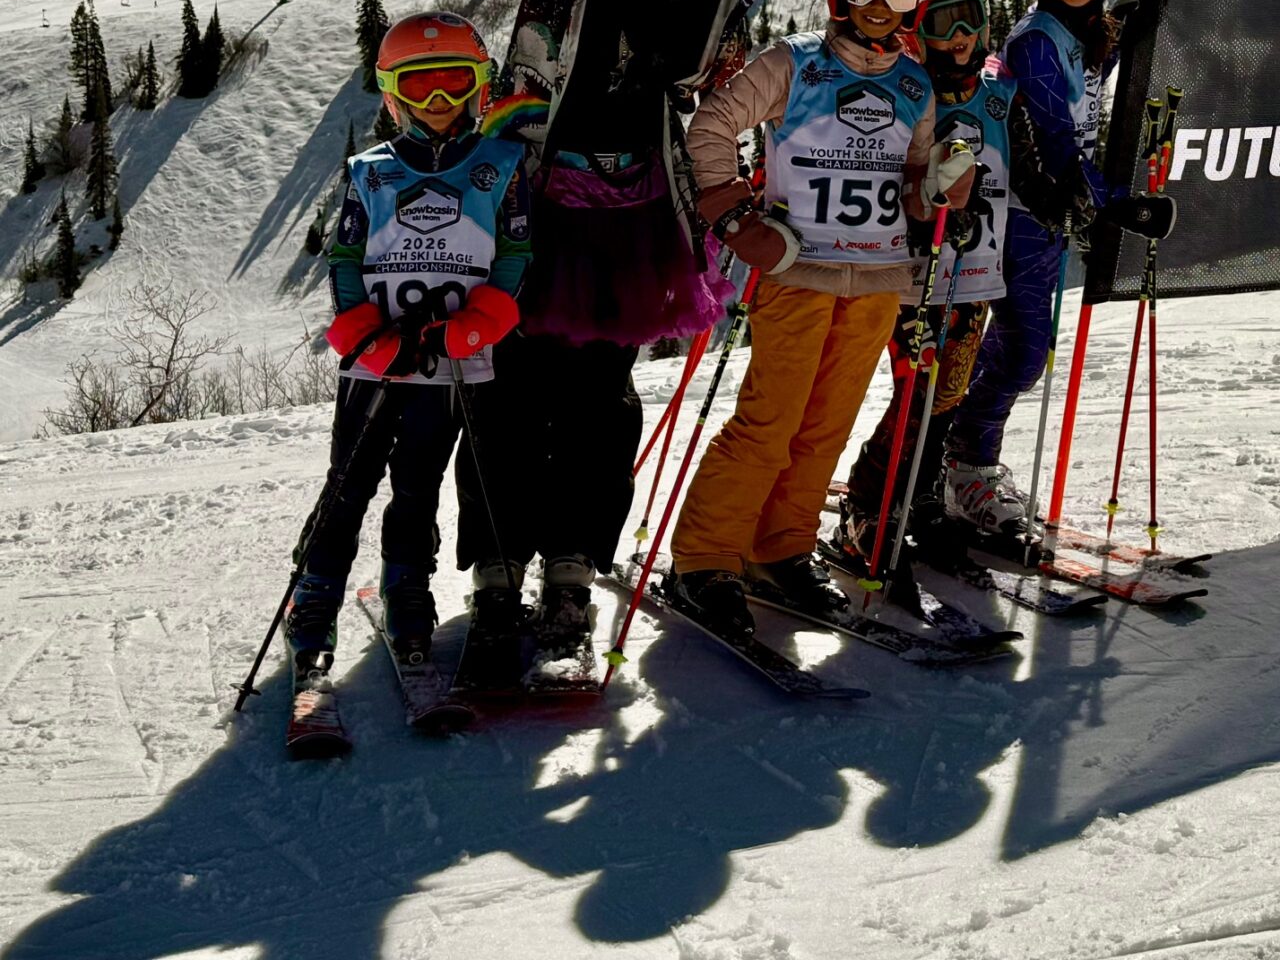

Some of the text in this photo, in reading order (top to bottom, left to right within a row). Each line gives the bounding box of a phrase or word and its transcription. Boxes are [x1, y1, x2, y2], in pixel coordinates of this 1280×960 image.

[840, 106, 893, 119] snowbasin
[845, 136, 886, 150] 2026
[809, 147, 905, 163] YOUTH SKI LEAGUE
[815, 160, 903, 173] CHAMPIONSHIPS
[808, 177, 901, 227] 159
[400, 204, 457, 217] snowbasin
[402, 237, 447, 250] 2026
[845, 241, 881, 250] ATOMIC
[410, 251, 430, 261] SKI
[434, 252, 474, 265] LEAGUE
[374, 263, 470, 276] CHAMPIONSHIPS
